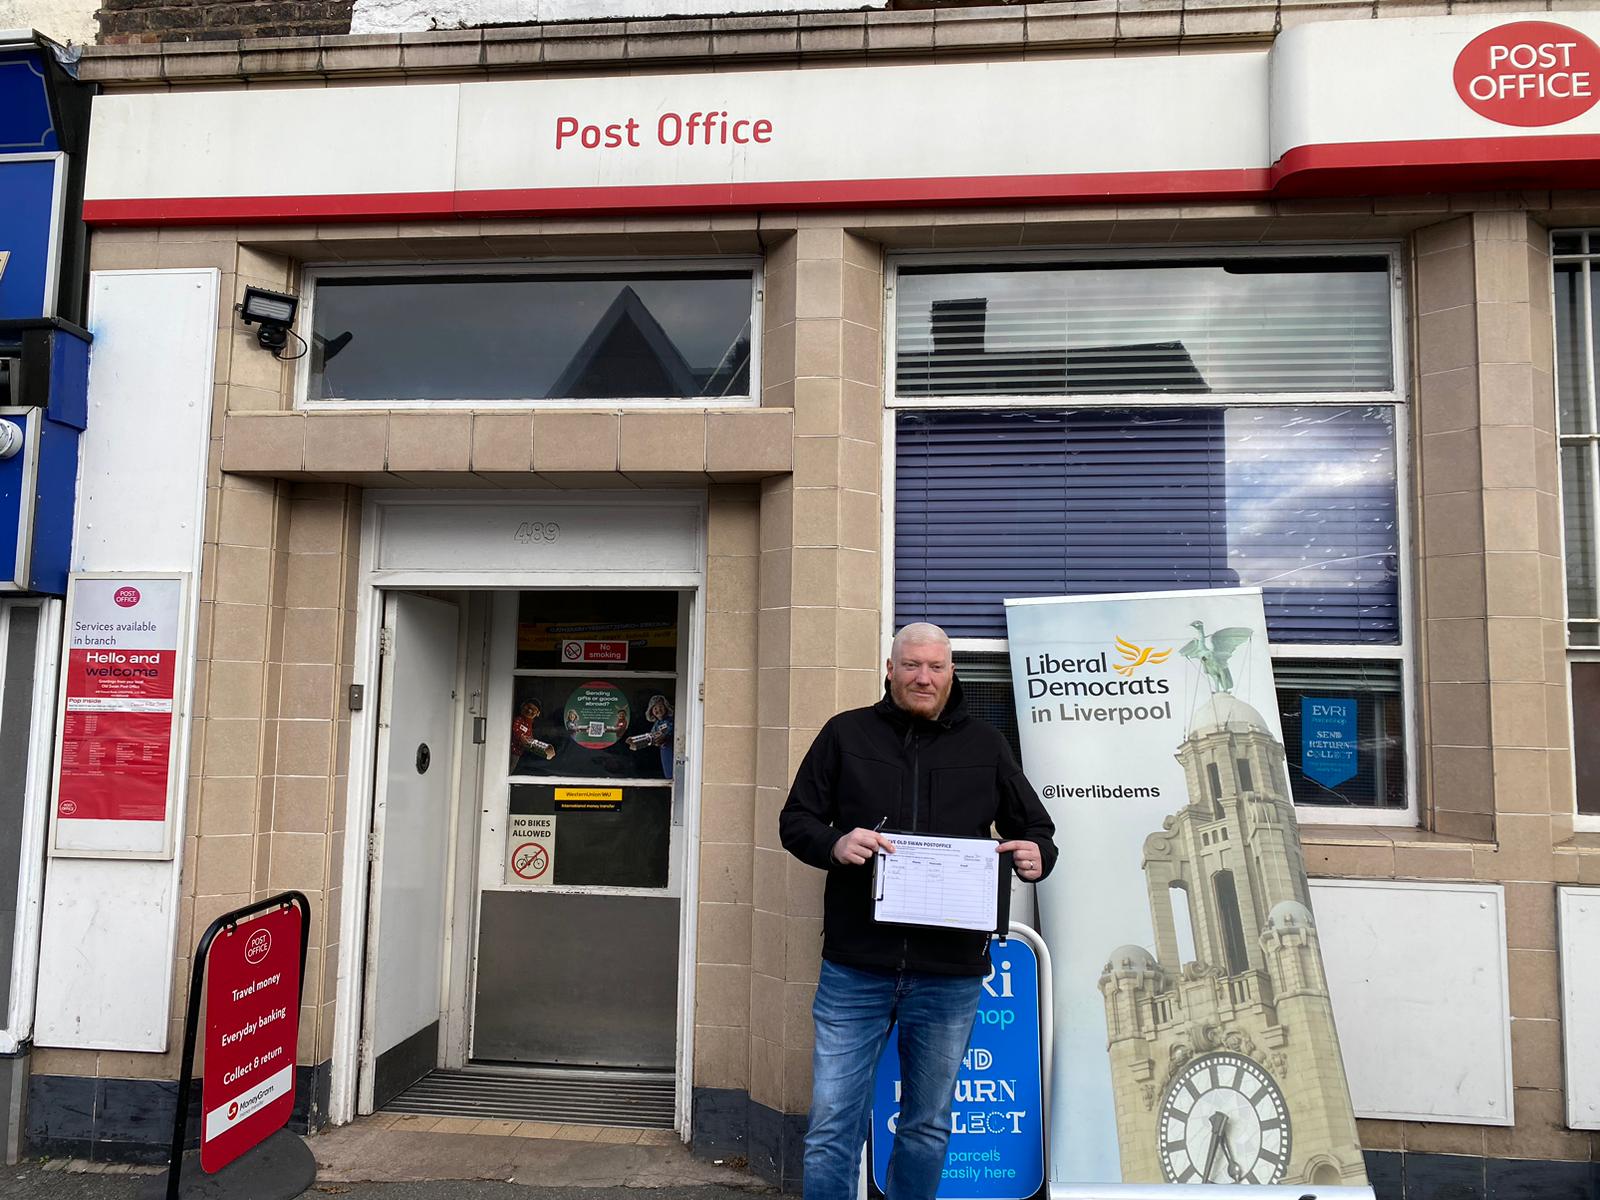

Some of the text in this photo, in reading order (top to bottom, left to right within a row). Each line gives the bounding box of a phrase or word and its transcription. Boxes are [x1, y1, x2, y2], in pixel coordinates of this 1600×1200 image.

[1490, 43, 1577, 70] POST
[1469, 72, 1592, 101] OFFICE
[555, 111, 773, 150] Post Office
[513, 521, 561, 545] 489
[75, 621, 157, 632] Services available
[74, 635, 117, 646] in branch
[600, 643, 611, 651] No
[86, 652, 160, 664] Hello and
[589, 651, 622, 660] smoking
[86, 667, 159, 678] welcome
[1025, 652, 1108, 677] Liberal
[1027, 675, 1170, 699] Democrats
[1031, 701, 1172, 725] in Liverpool
[1316, 731, 1342, 739] SEND
[1042, 784, 1161, 799] @liverlibdems
[513, 819, 551, 828] NO BIKES
[512, 829, 552, 838] ALLOWED
[251, 934, 267, 948] POST
[247, 942, 268, 958] OFFICE
[232, 972, 281, 1002] Travel money
[221, 1006, 286, 1047] Everyday banking
[223, 1045, 283, 1086] Collect & return
[240, 1085, 274, 1111] MoneyGram
[948, 1149, 1001, 1166] parcels
[941, 1165, 1016, 1183] easily here
